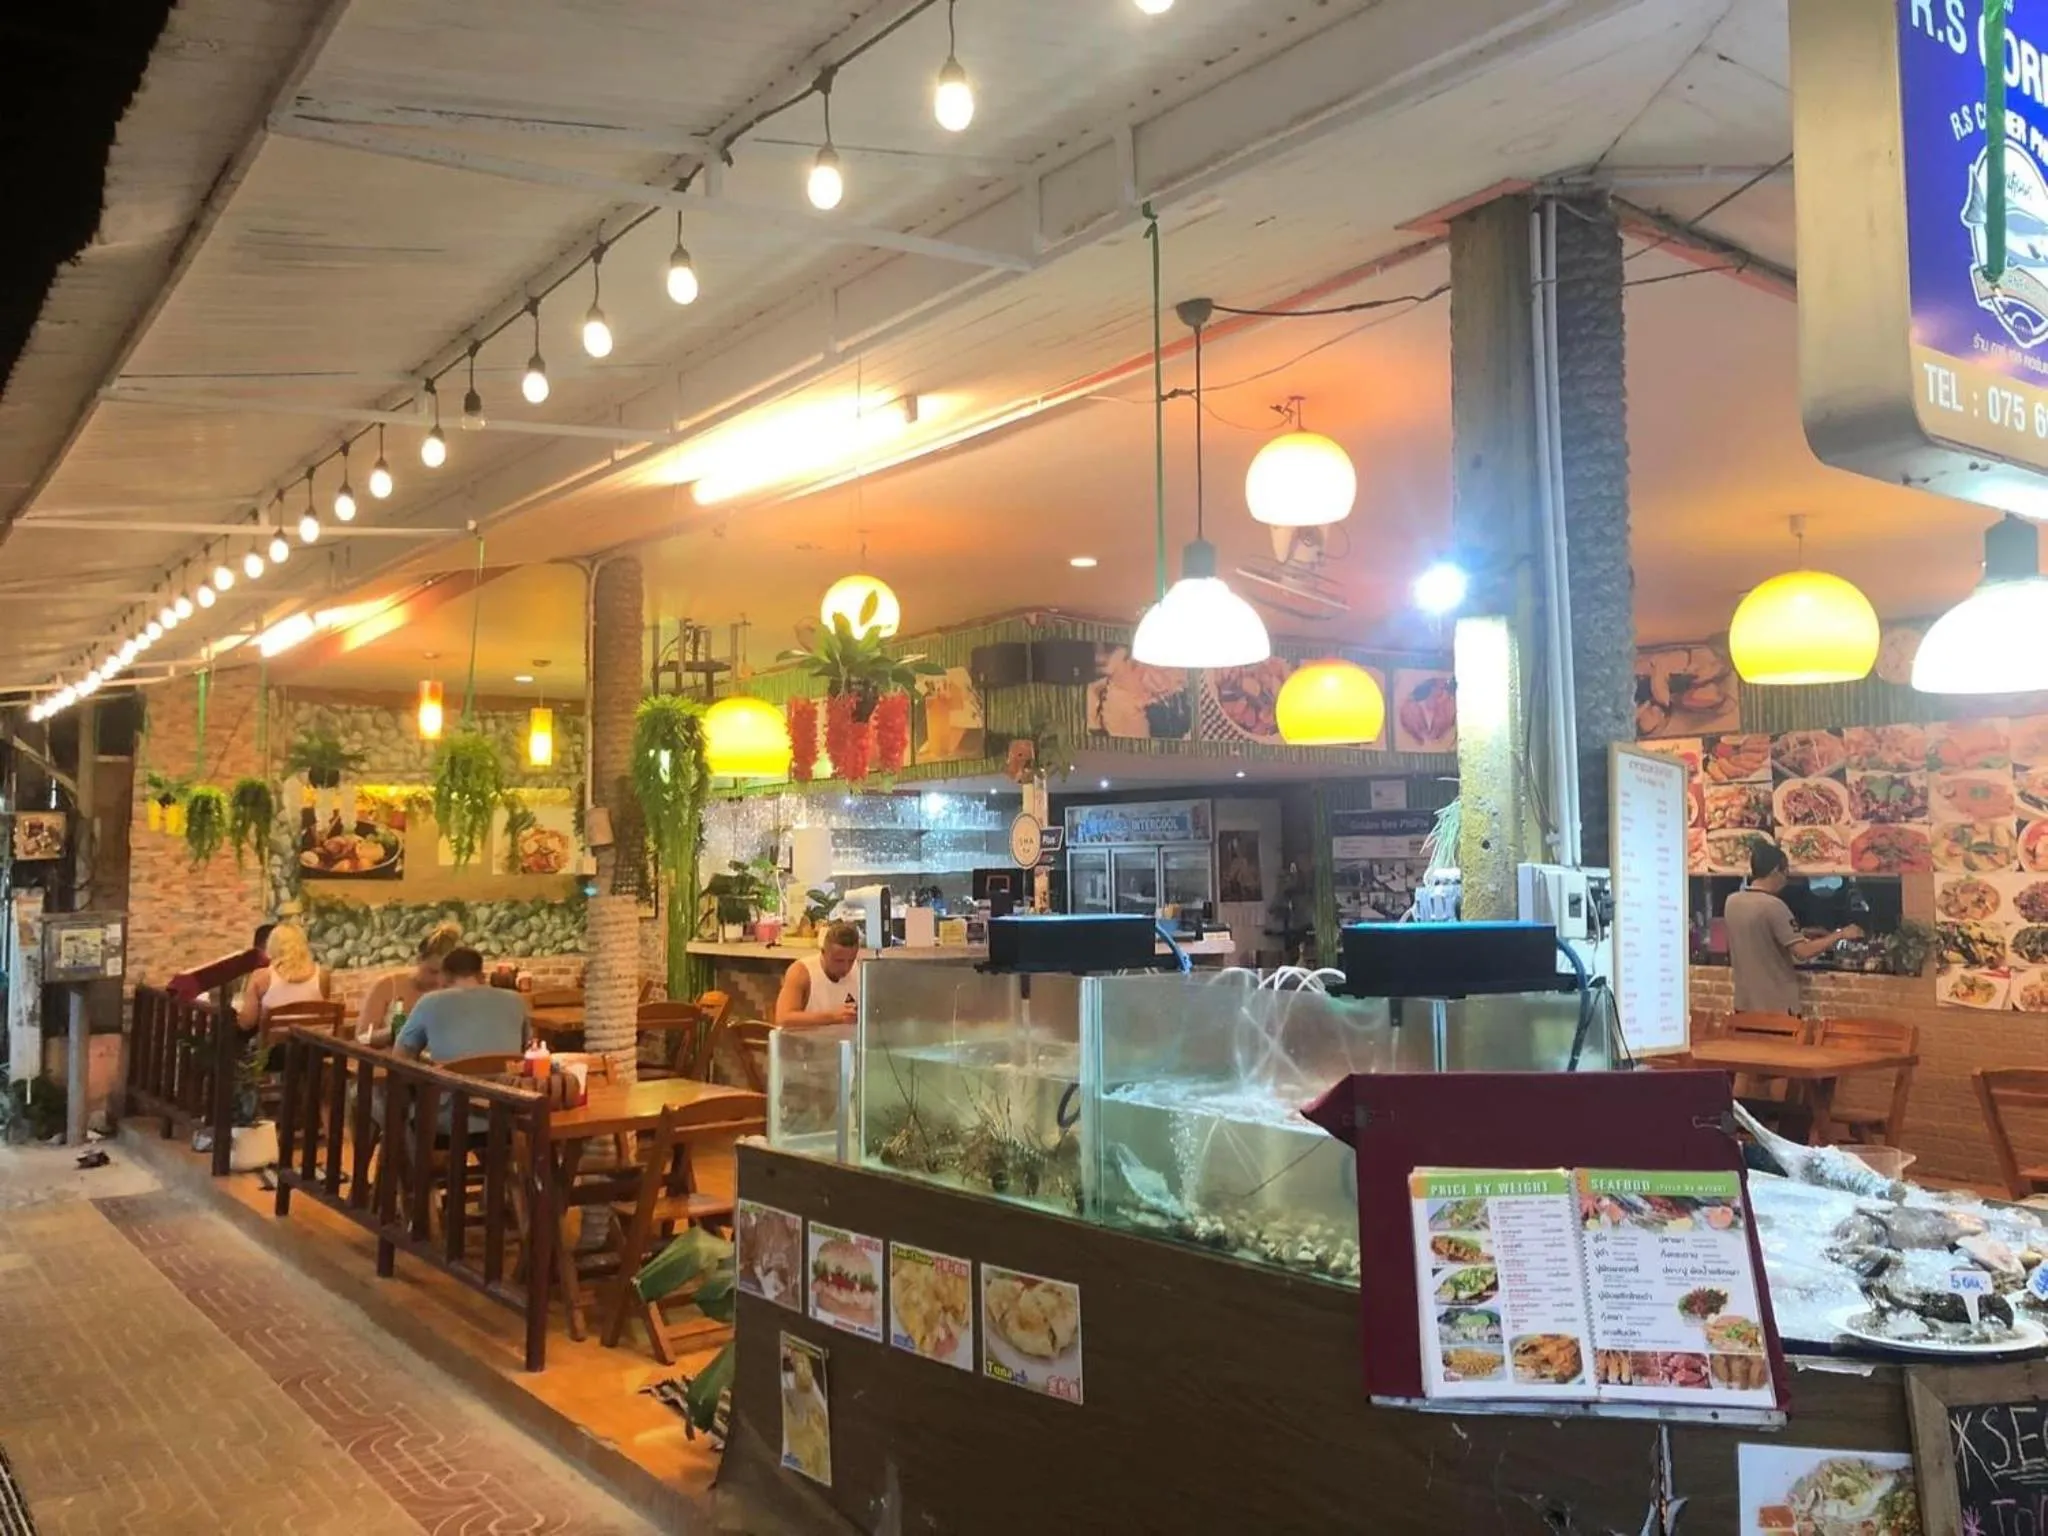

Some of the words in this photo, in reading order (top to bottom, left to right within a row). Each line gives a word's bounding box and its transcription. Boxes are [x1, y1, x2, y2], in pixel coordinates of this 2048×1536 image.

[1923, 362, 1964, 413] TEL
[1988, 386, 2026, 432] 075
[1430, 1183, 1467, 1198] PRICE
[1475, 1183, 1492, 1195] BY
[1498, 1181, 1549, 1194] WEIGHT
[1590, 1178, 1651, 1191] SEAFOOD
[986, 1361, 1013, 1378] Tuna
